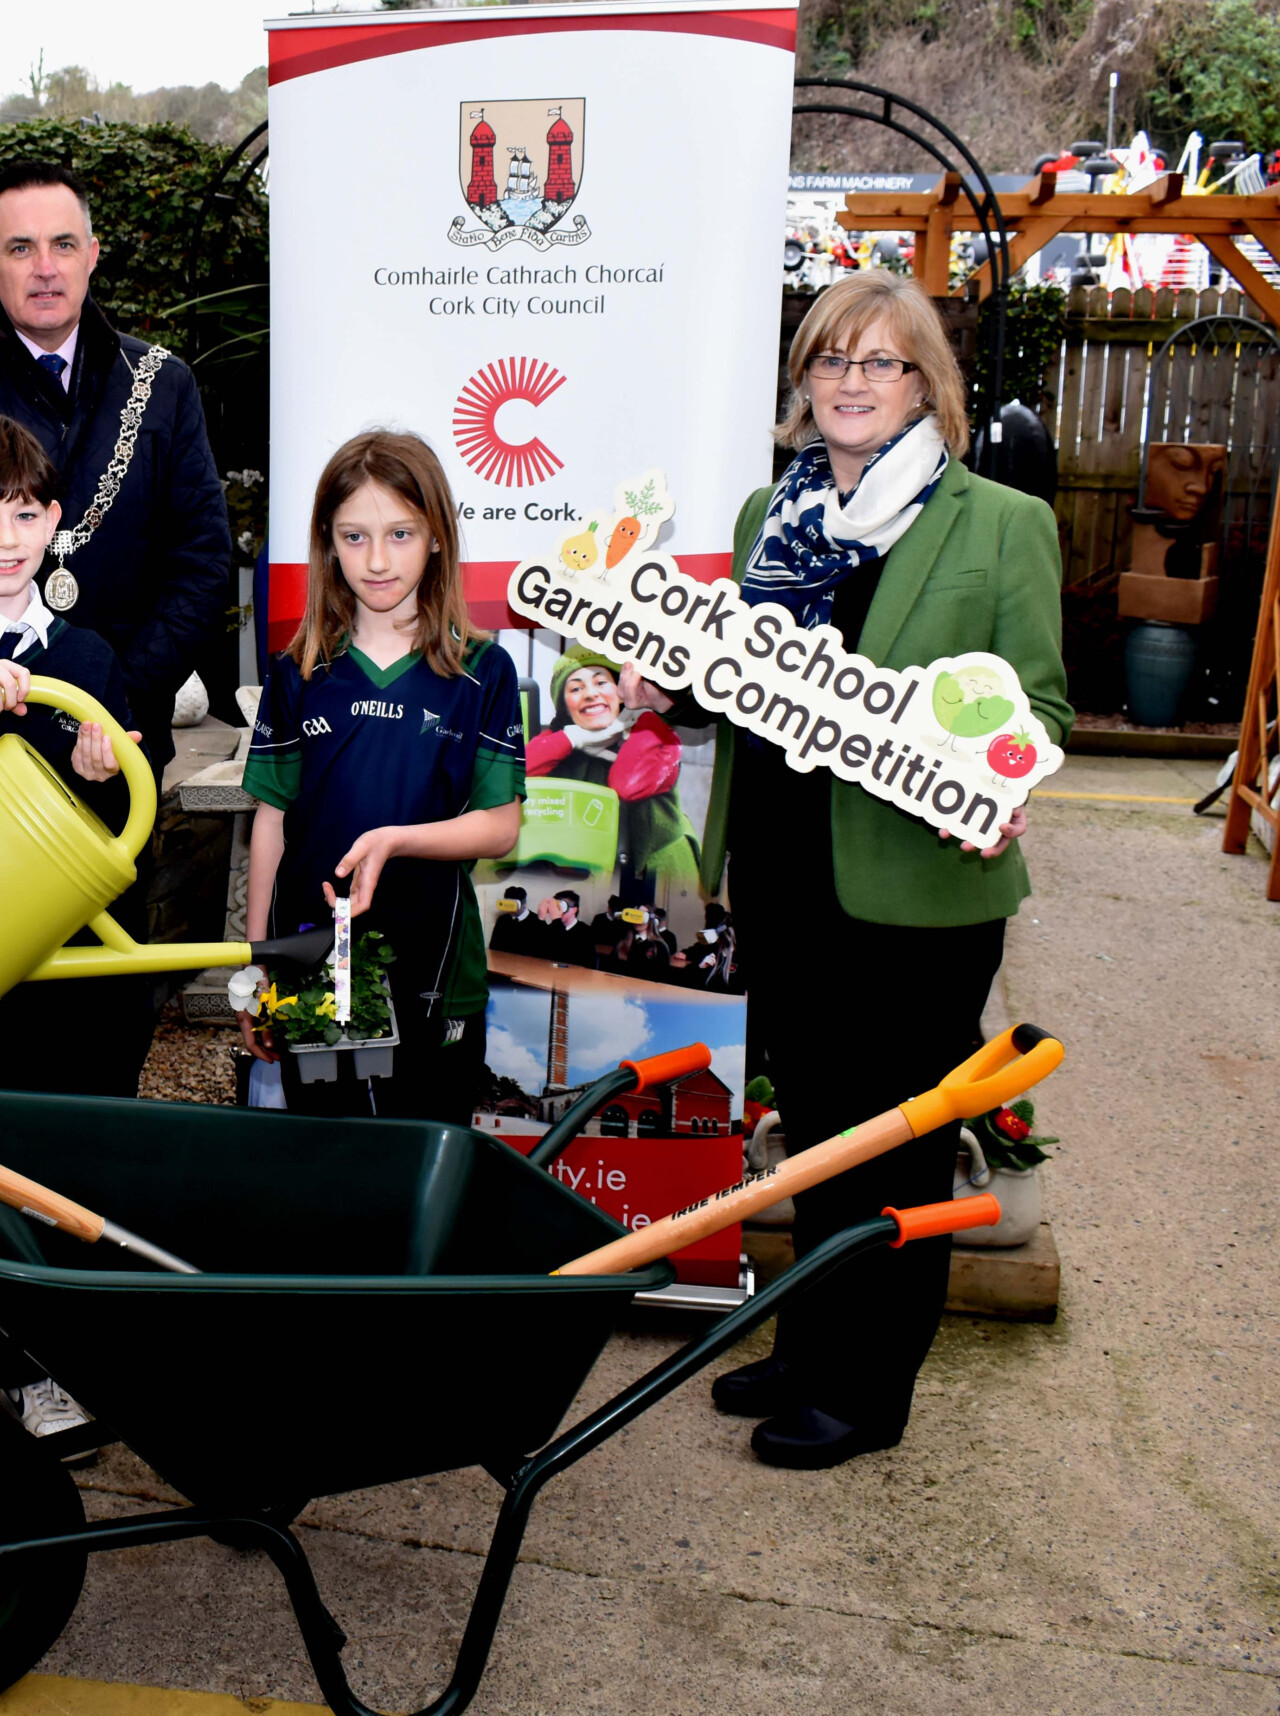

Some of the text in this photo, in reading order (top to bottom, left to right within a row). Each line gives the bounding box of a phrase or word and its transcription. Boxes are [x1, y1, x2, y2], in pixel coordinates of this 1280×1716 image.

[806, 176, 840, 189] FARM
[841, 176, 914, 190] MACHINERY
[374, 262, 665, 286] Comhairle Cathrach Chorcaí
[429, 295, 605, 318] Cork City Council
[483, 506, 516, 520] are
[524, 502, 583, 521] Cork.
[631, 563, 919, 725] Cork School
[351, 700, 404, 719] O'NEILLS
[517, 565, 998, 835] Gardens Competition
[538, 797, 566, 805] mixed
